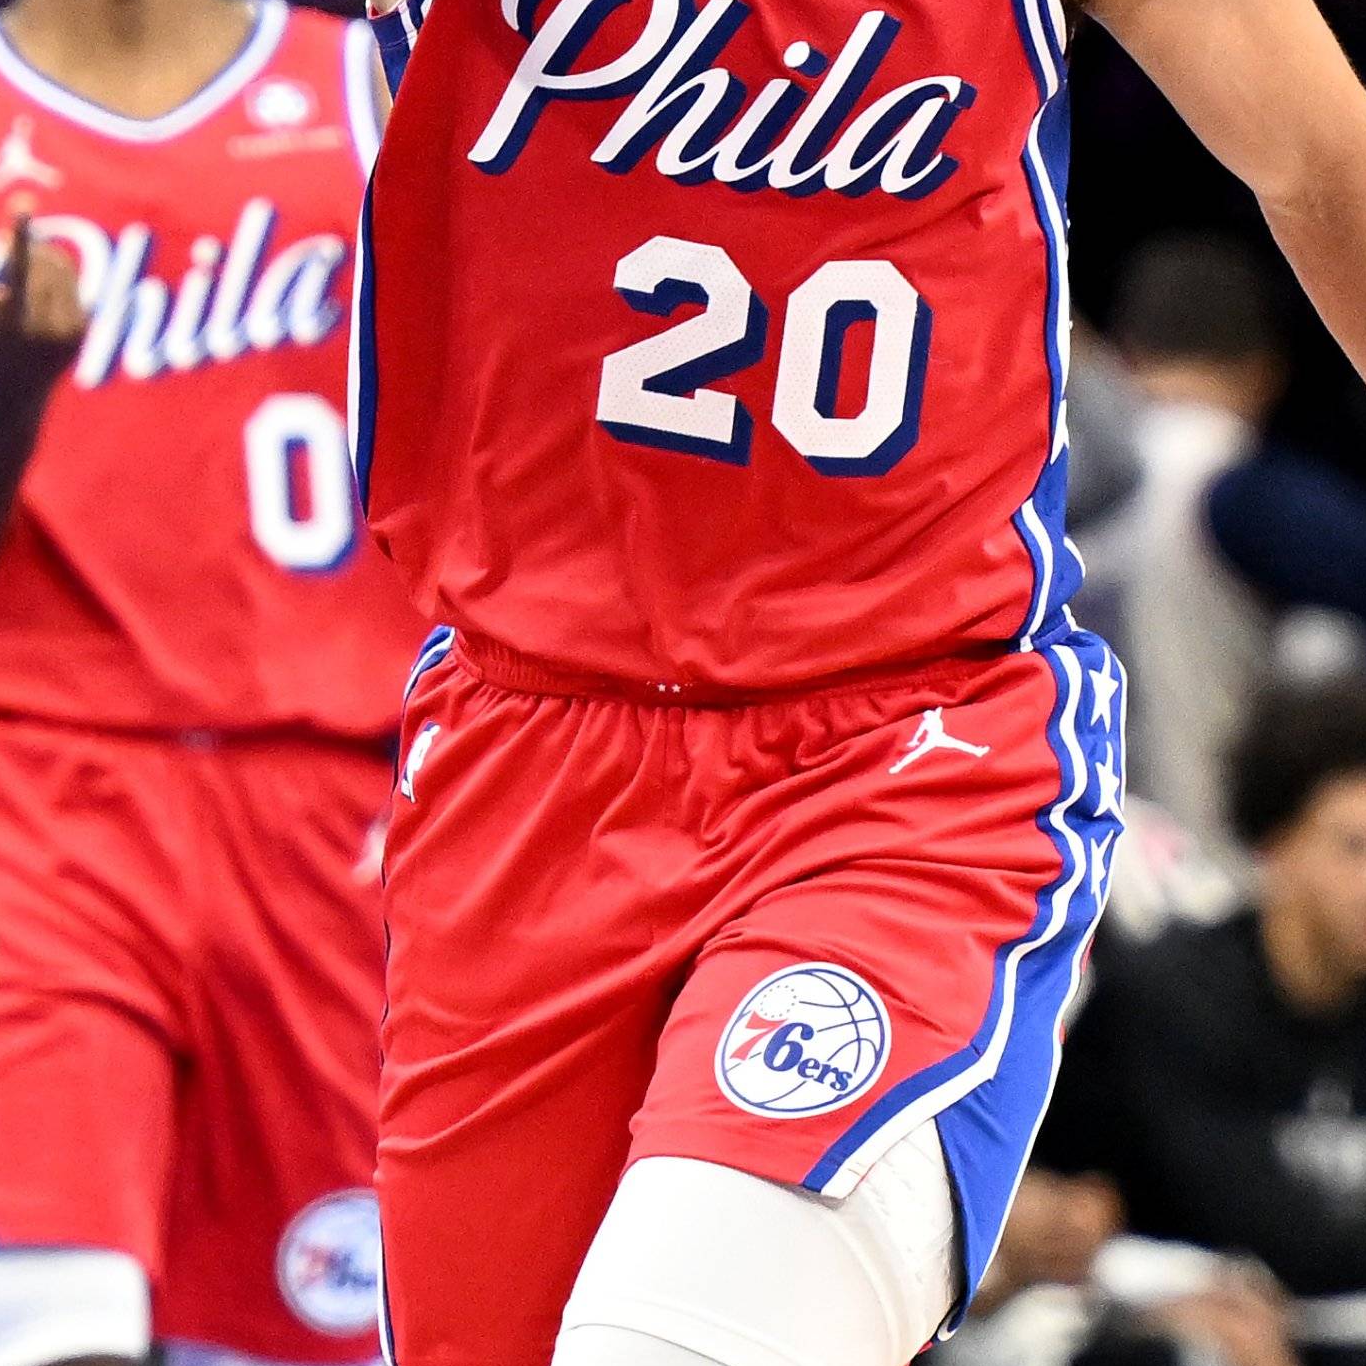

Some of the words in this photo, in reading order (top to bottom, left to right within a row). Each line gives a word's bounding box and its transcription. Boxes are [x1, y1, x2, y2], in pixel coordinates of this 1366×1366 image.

[595, 235, 933, 477] 20
[244, 391, 358, 574] 0
[729, 1010, 854, 1092] 76ers
